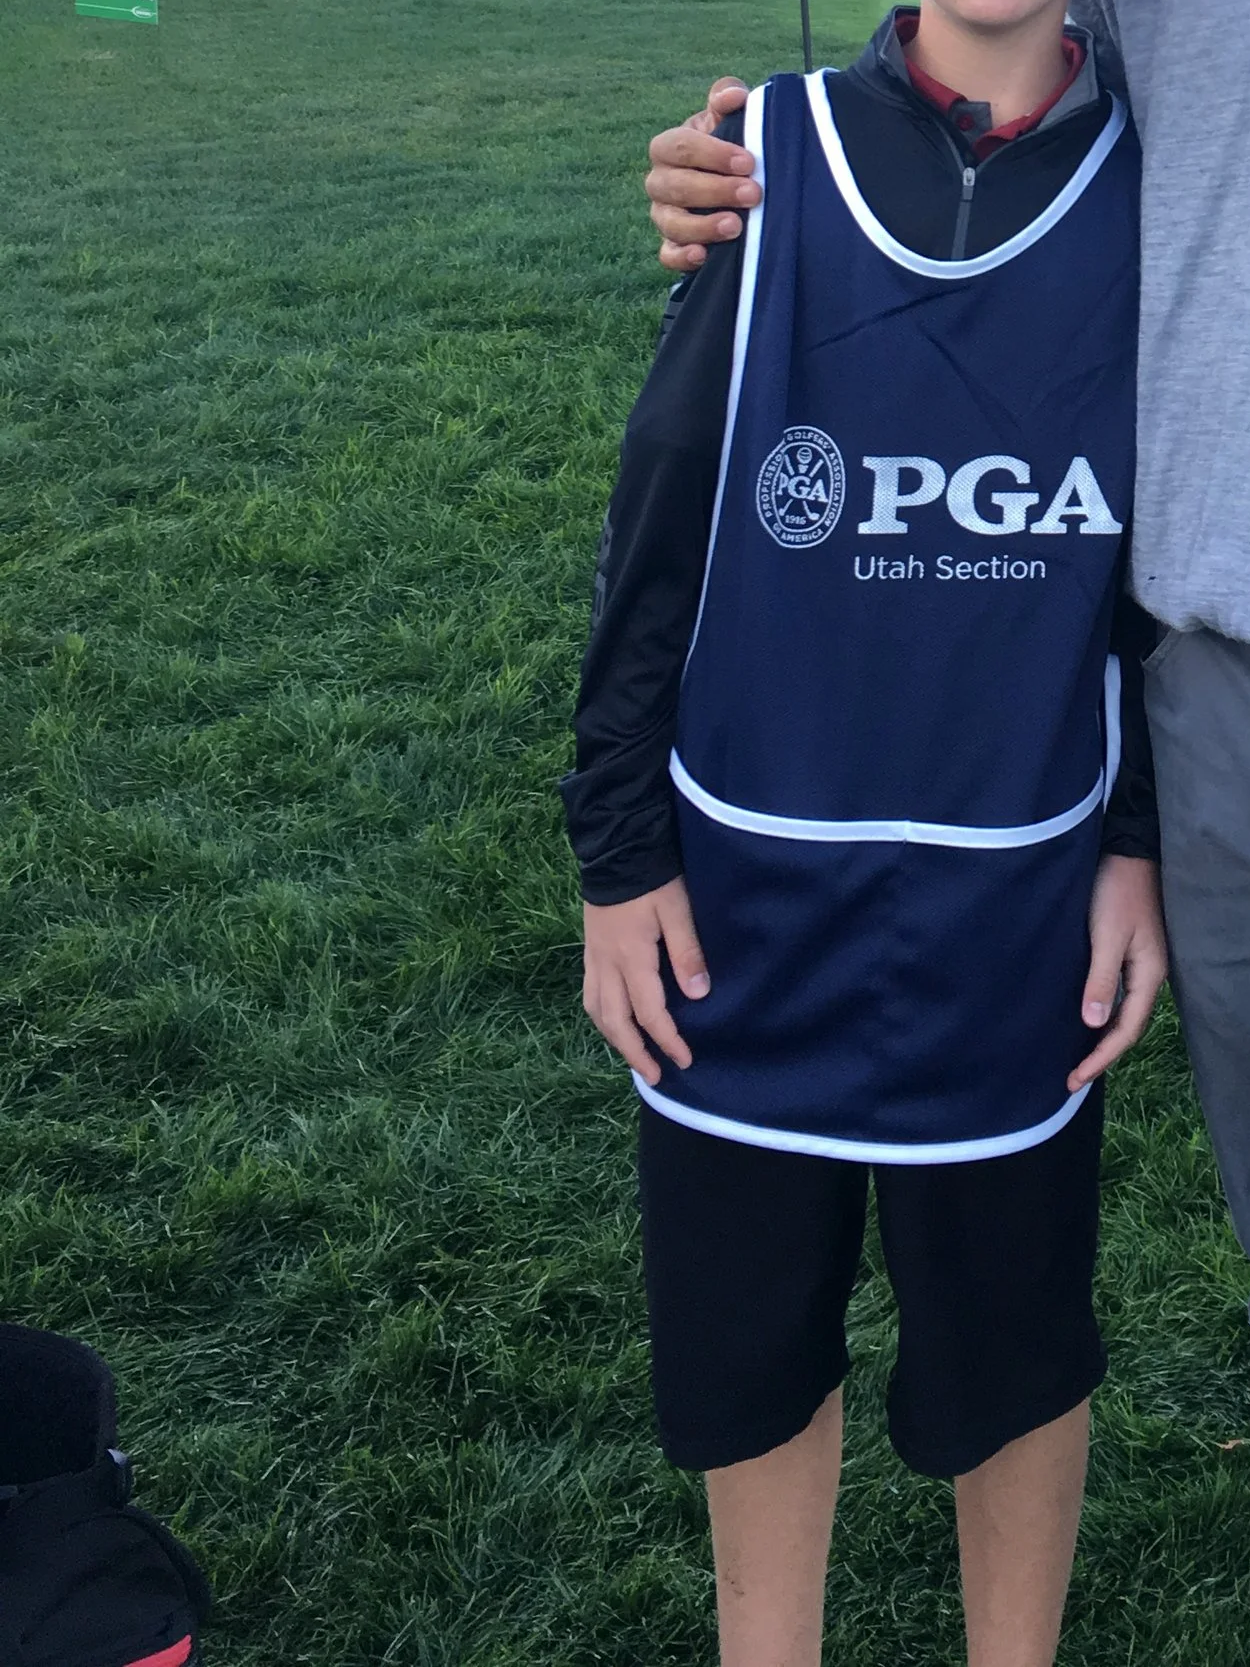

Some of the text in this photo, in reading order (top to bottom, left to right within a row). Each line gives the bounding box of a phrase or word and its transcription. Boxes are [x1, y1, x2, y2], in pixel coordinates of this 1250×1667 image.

[776, 472, 829, 503] PGA
[824, 452, 841, 527] ASSOCIATION
[857, 454, 1124, 535] PGA
[780, 528, 824, 543] AMERICA
[853, 554, 1047, 581] Utah Section
